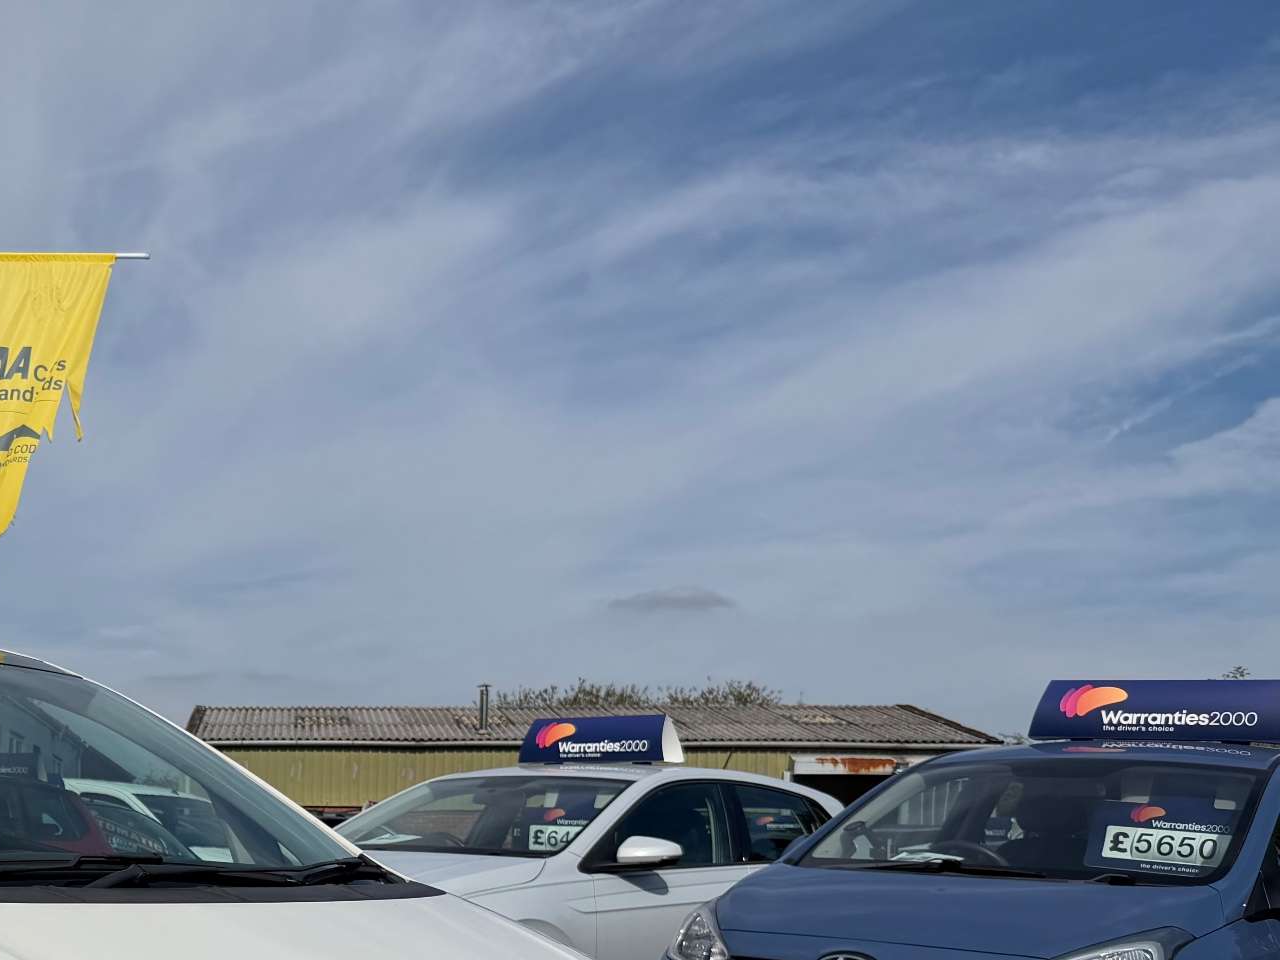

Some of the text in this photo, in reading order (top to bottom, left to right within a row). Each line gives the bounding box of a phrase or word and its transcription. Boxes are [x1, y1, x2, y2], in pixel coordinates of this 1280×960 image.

[1101, 710, 1258, 726] Warranties2000
[558, 740, 648, 753] Warranties2000
[1151, 819, 1232, 834] Warranties2000
[531, 829, 571, 847] £64
[1109, 831, 1218, 860] £5650
